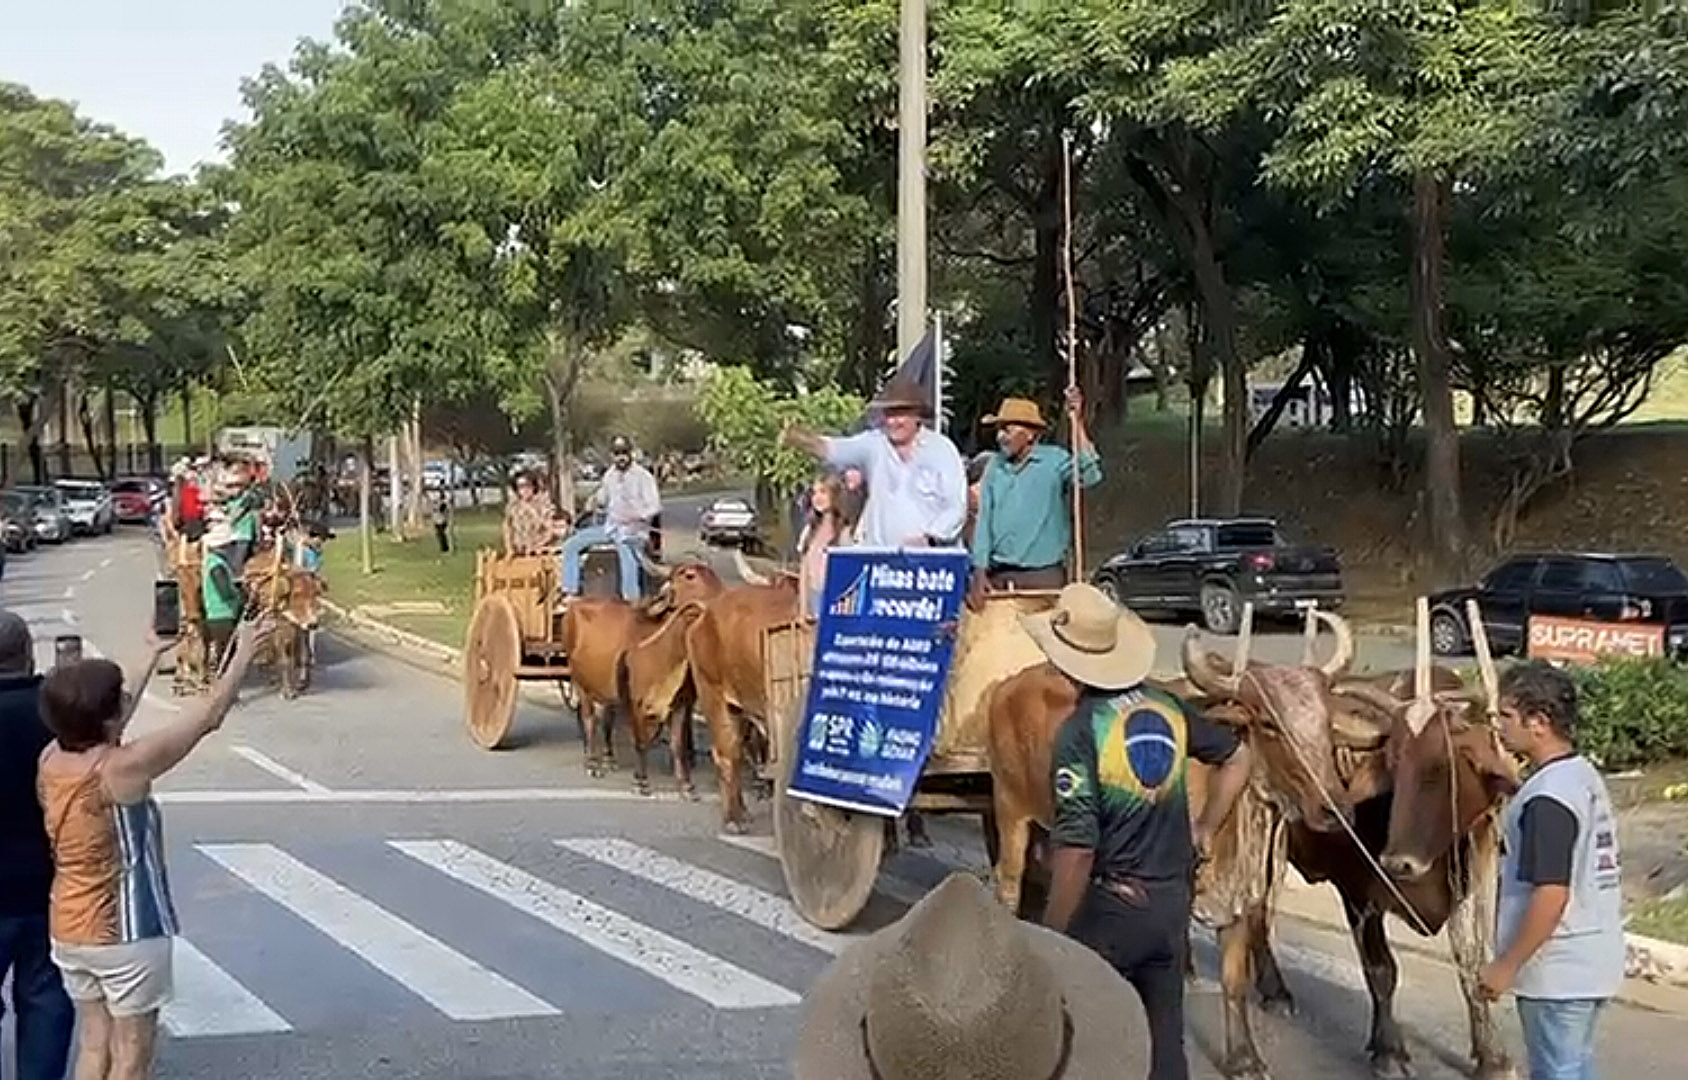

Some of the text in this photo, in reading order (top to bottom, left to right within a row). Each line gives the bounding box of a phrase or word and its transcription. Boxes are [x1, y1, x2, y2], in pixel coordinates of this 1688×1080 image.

[870, 564, 955, 592] Minas bate
[868, 597, 944, 621] recorde!
[1531, 623, 1658, 657] SUPRAMET
